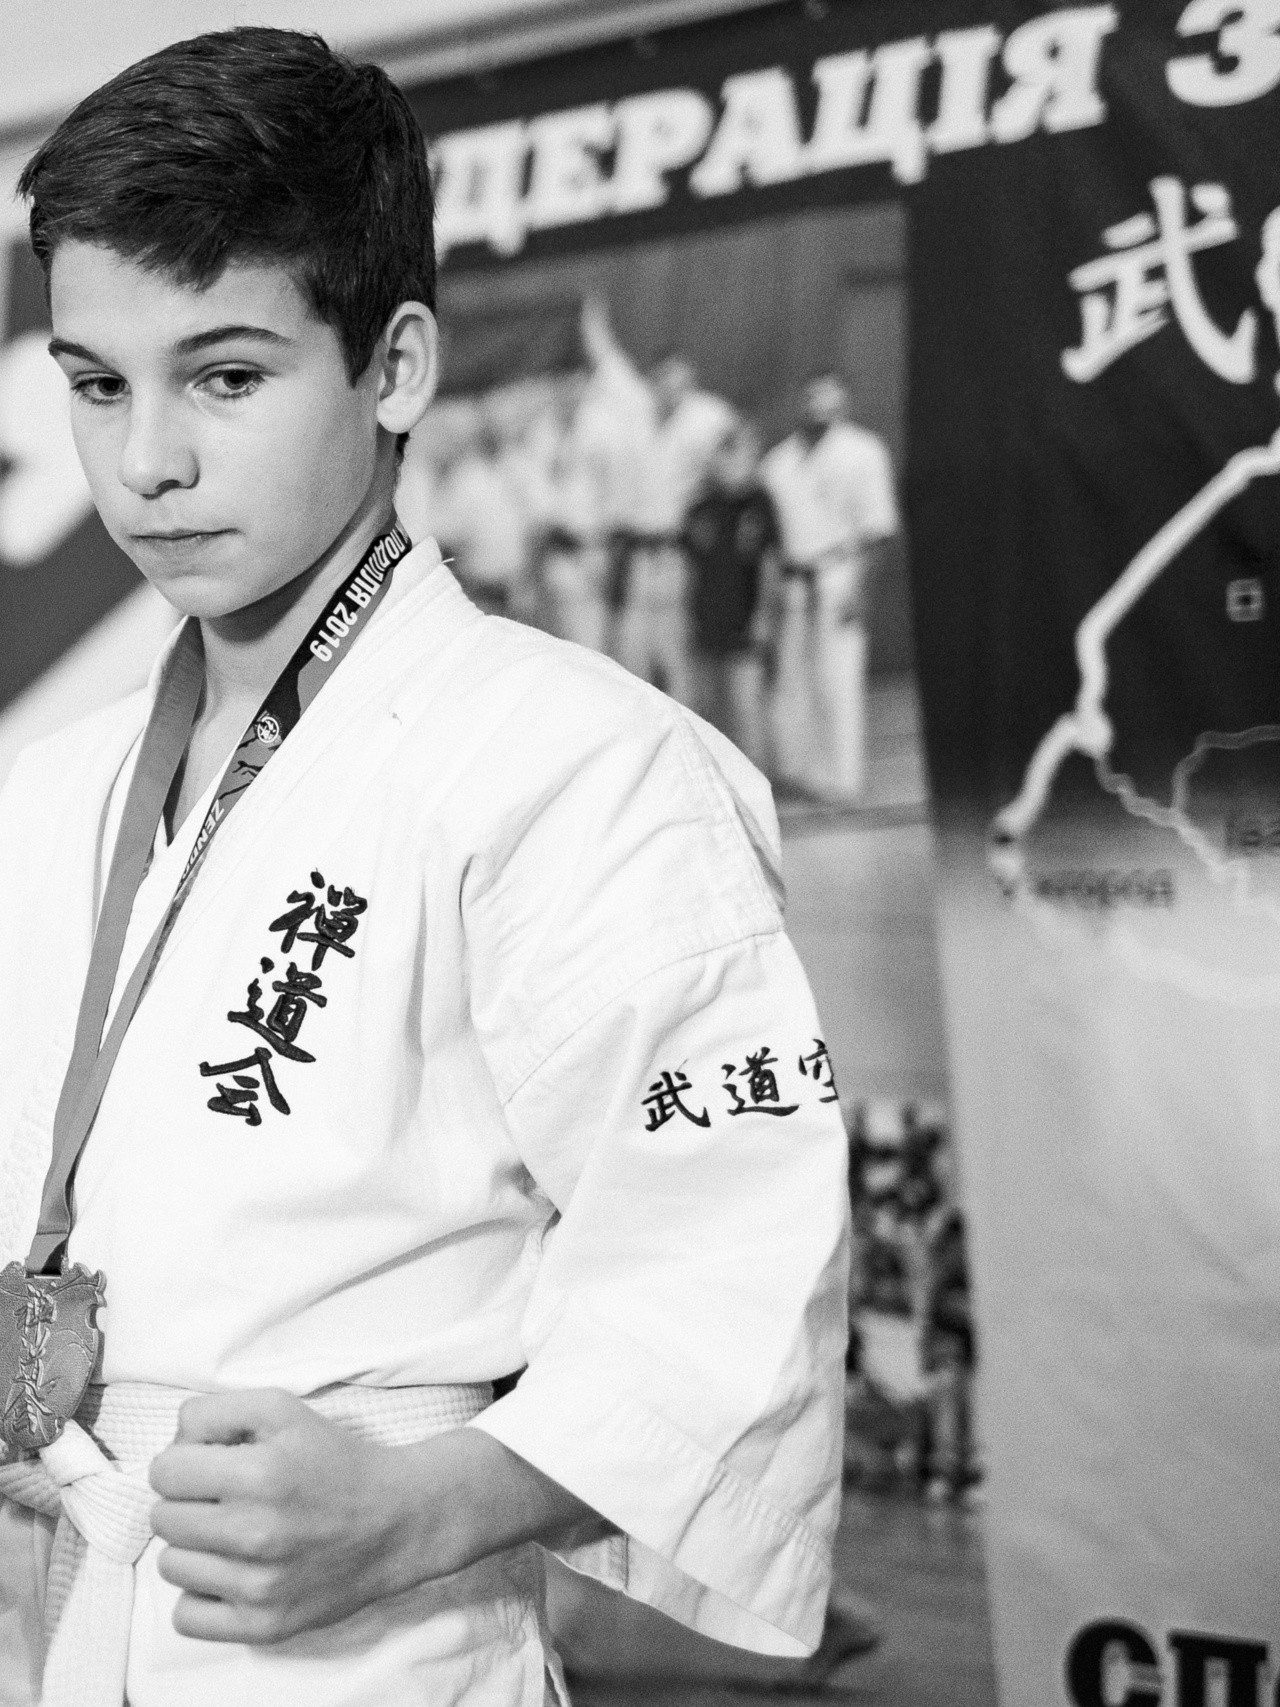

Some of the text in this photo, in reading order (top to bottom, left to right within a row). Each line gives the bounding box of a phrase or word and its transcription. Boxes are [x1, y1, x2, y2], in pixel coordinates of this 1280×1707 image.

[1061, 176, 1280, 390] 武
[309, 528, 407, 663] ПОДІЛЛЯ 2019
[1064, 1616, 1280, 1707] СП
